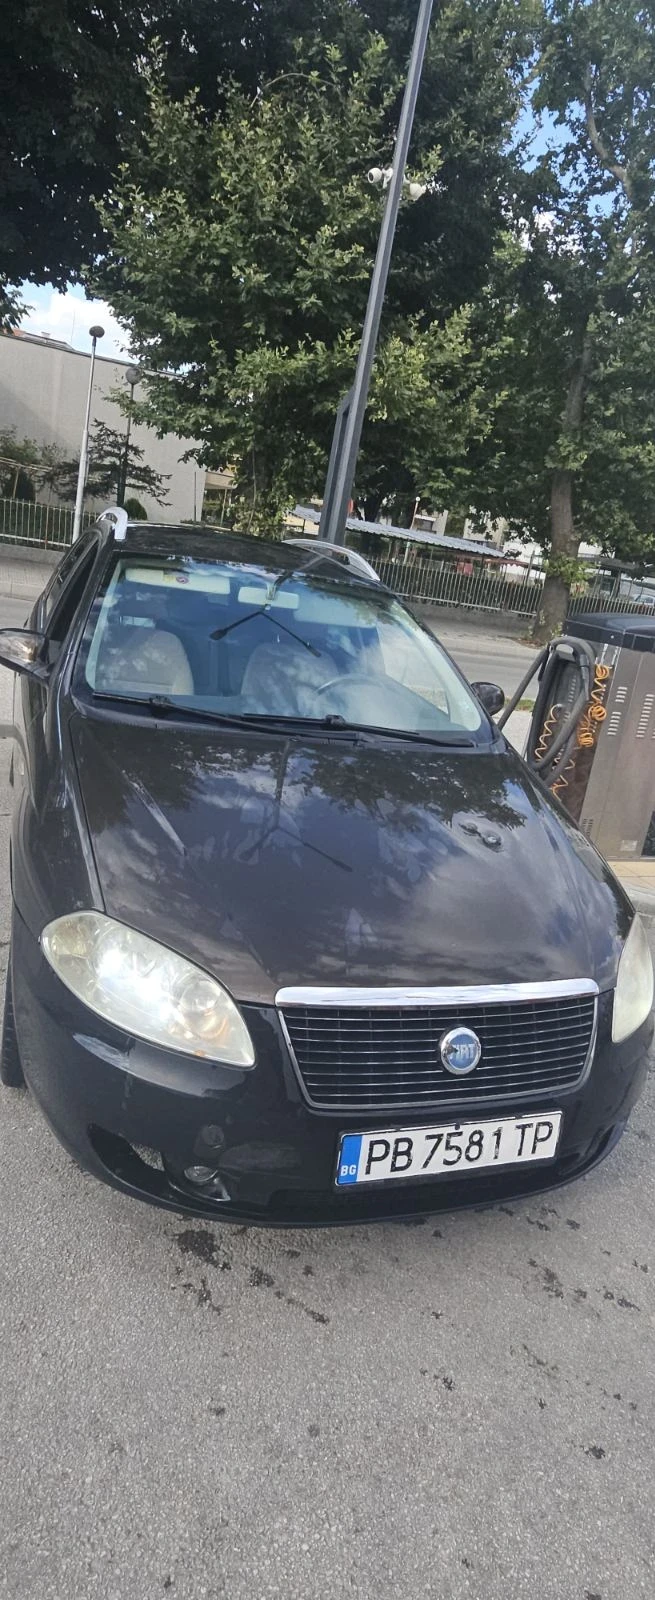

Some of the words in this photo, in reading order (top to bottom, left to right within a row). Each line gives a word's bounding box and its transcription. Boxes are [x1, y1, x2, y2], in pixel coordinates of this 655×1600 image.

[365, 1137, 414, 1175] PB
[421, 1127, 503, 1169] 7581
[515, 1121, 553, 1156] TP
[340, 1164, 357, 1177] BG
